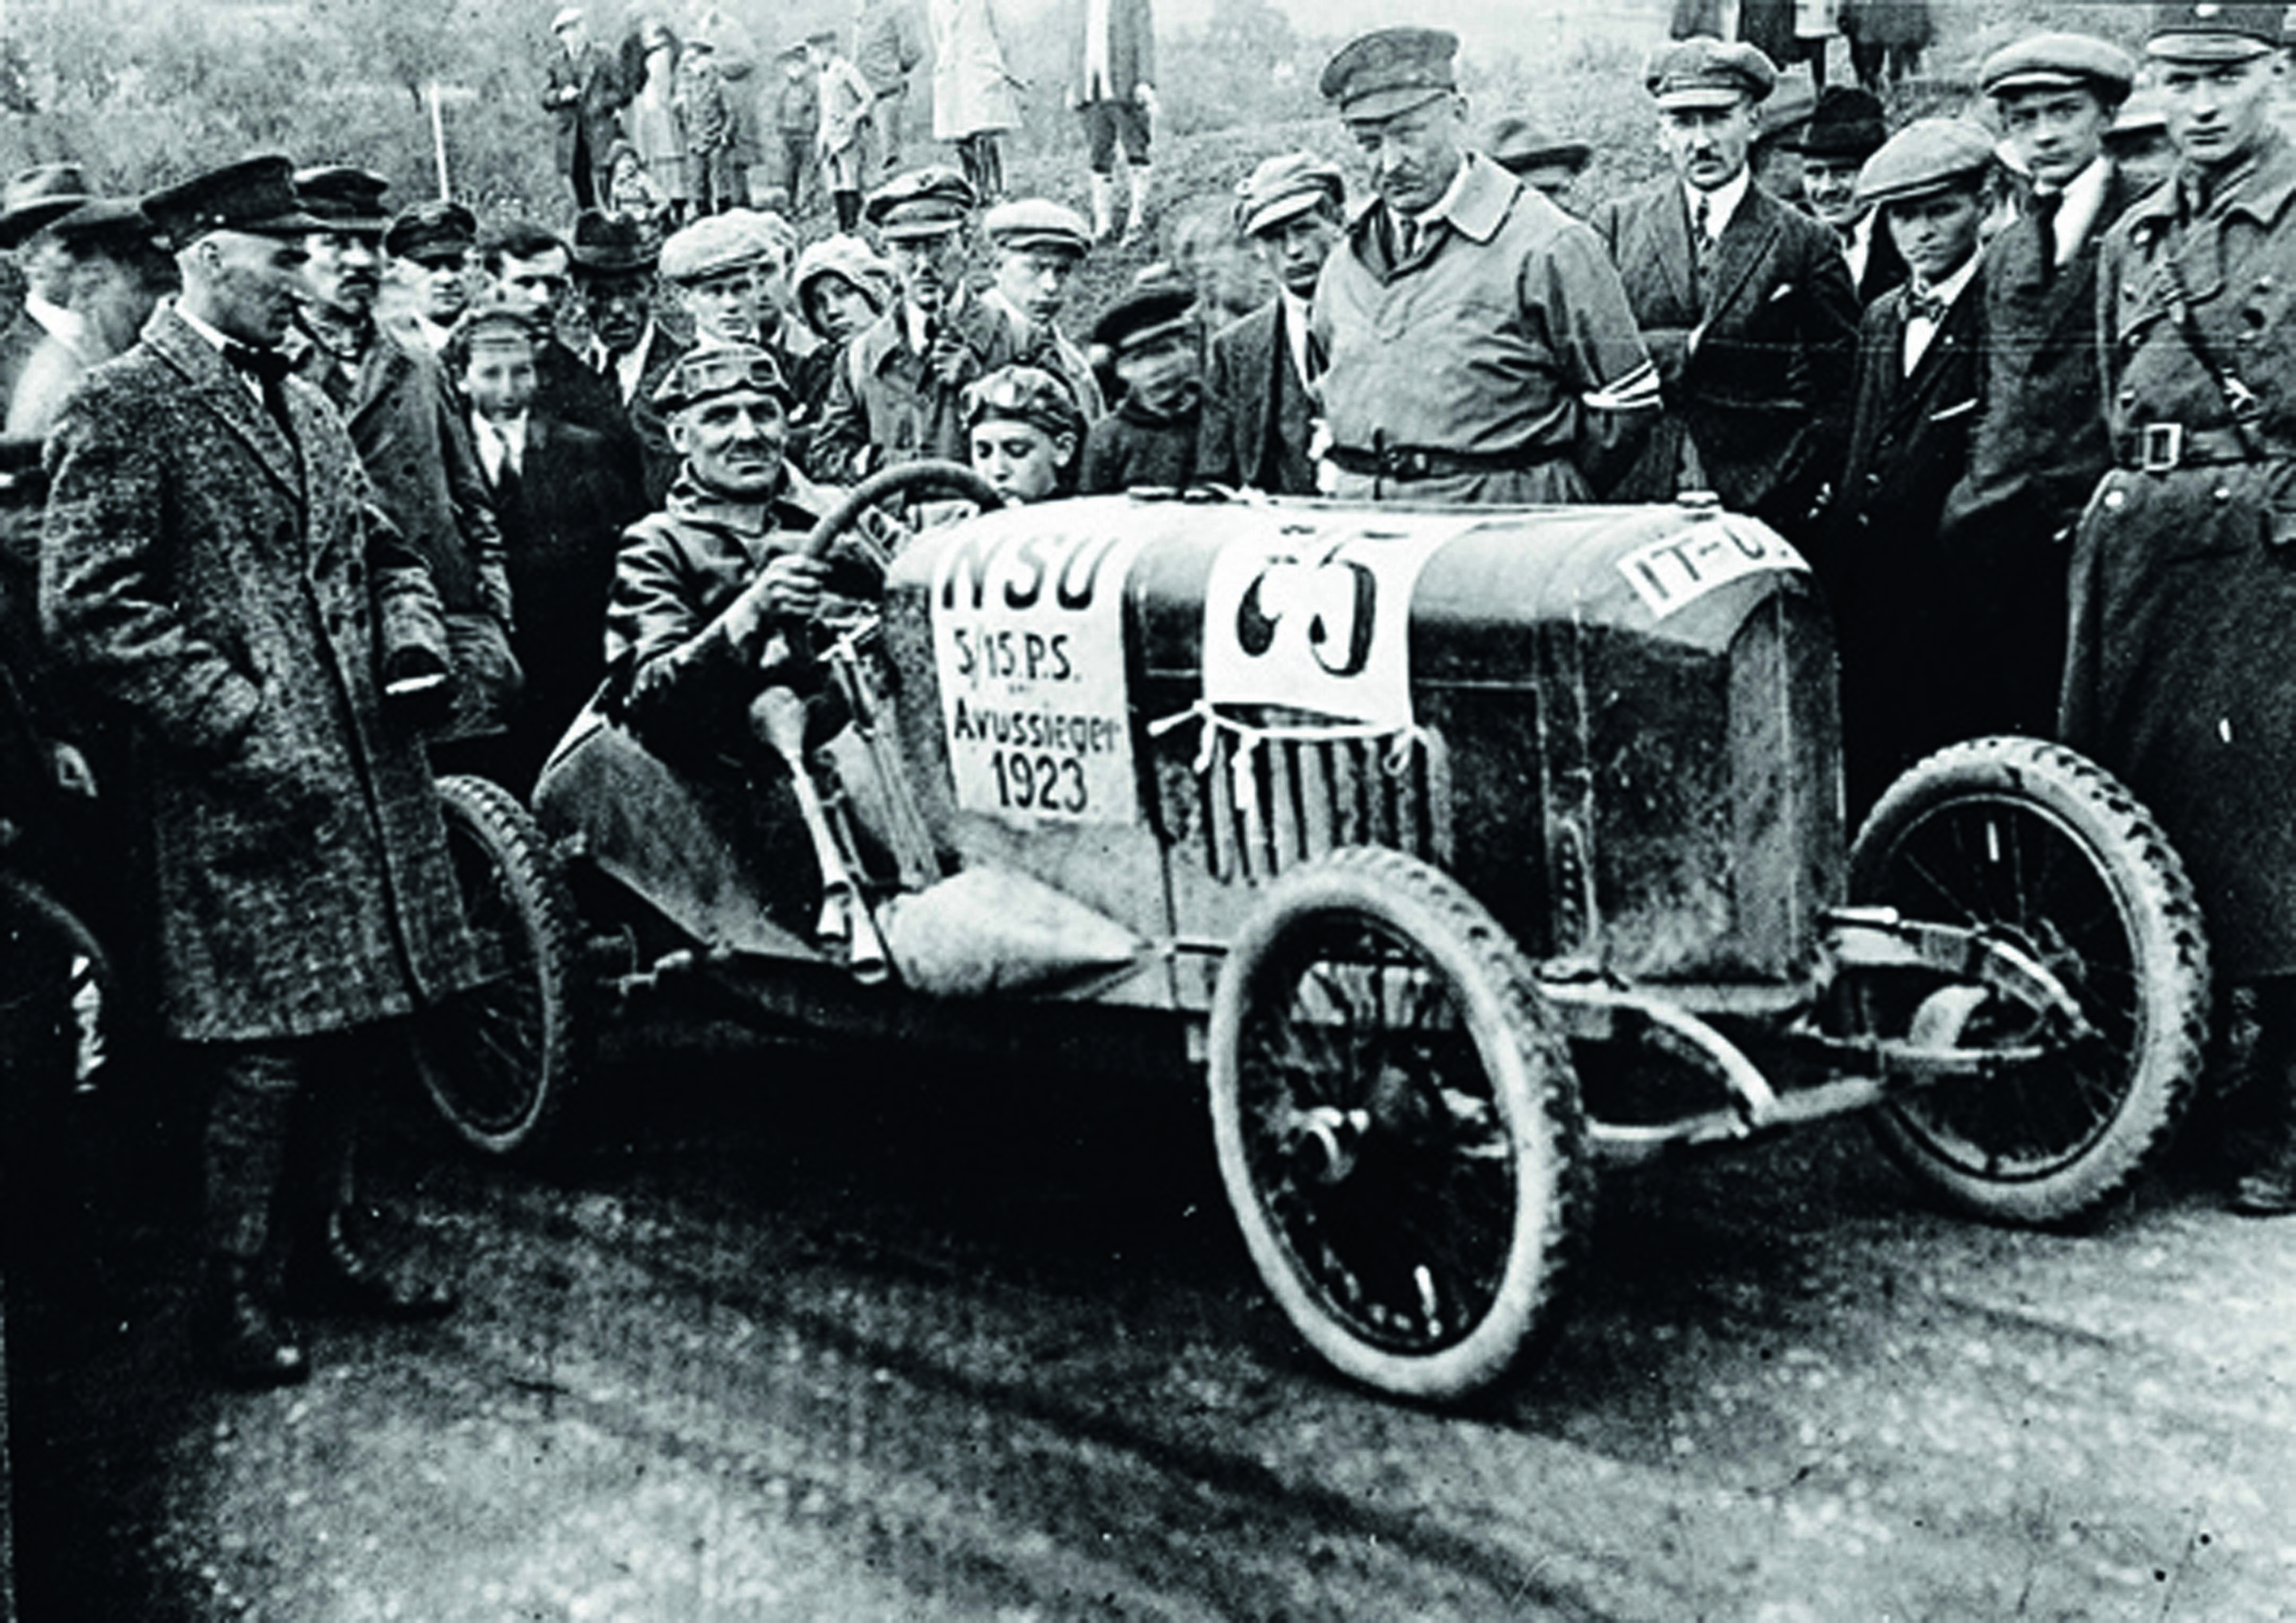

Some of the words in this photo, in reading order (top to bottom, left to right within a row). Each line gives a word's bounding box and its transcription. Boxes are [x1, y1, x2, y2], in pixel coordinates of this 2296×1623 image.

[941, 534, 1121, 611] NSU
[954, 698, 1121, 757] Avussieger
[992, 750, 1089, 815] 1923
